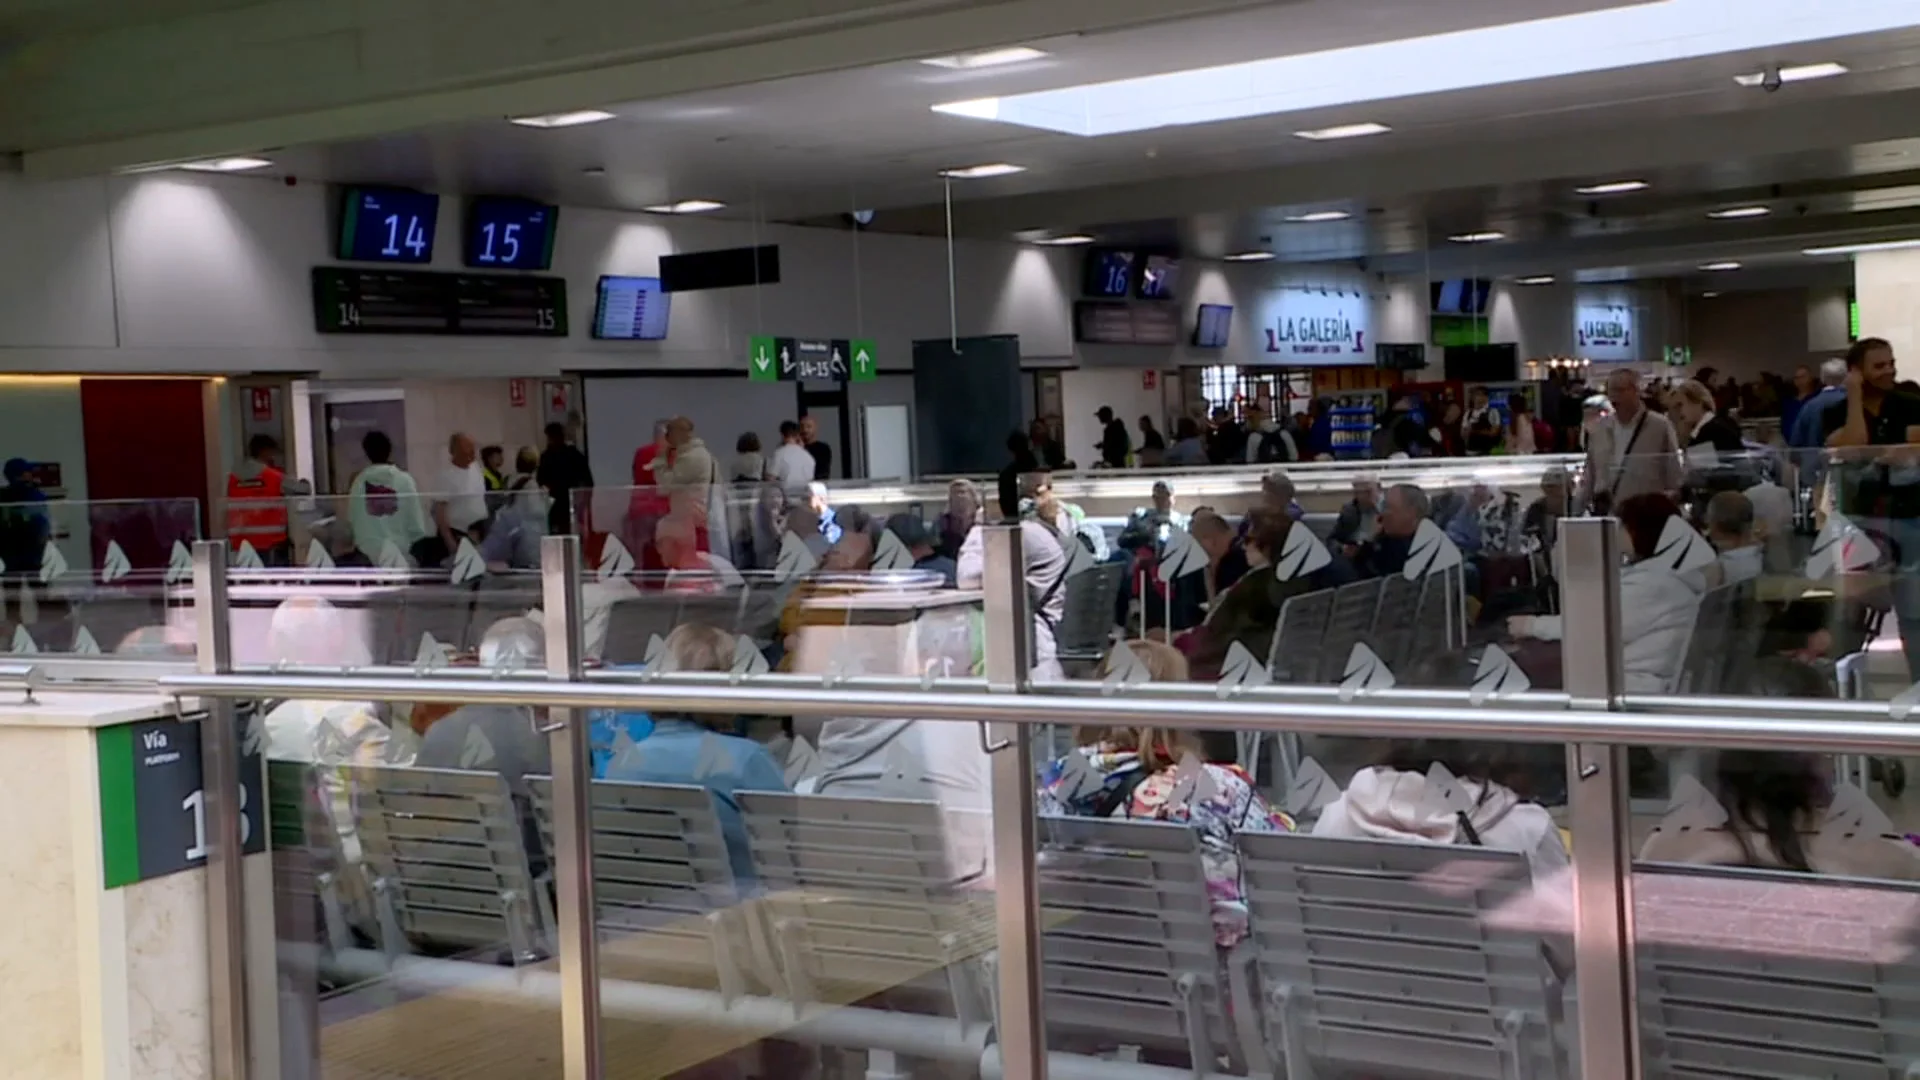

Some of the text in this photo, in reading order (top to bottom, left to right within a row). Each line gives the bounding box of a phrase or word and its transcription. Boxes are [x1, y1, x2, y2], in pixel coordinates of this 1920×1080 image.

[381, 213, 426, 257] 14
[479, 222, 521, 263] 15
[1104, 265, 1127, 293] 16
[338, 303, 360, 326] 14
[537, 308, 555, 330] 15
[1277, 316, 1296, 342] LA
[800, 361, 829, 377] 14-15
[143, 730, 168, 749] Vía
